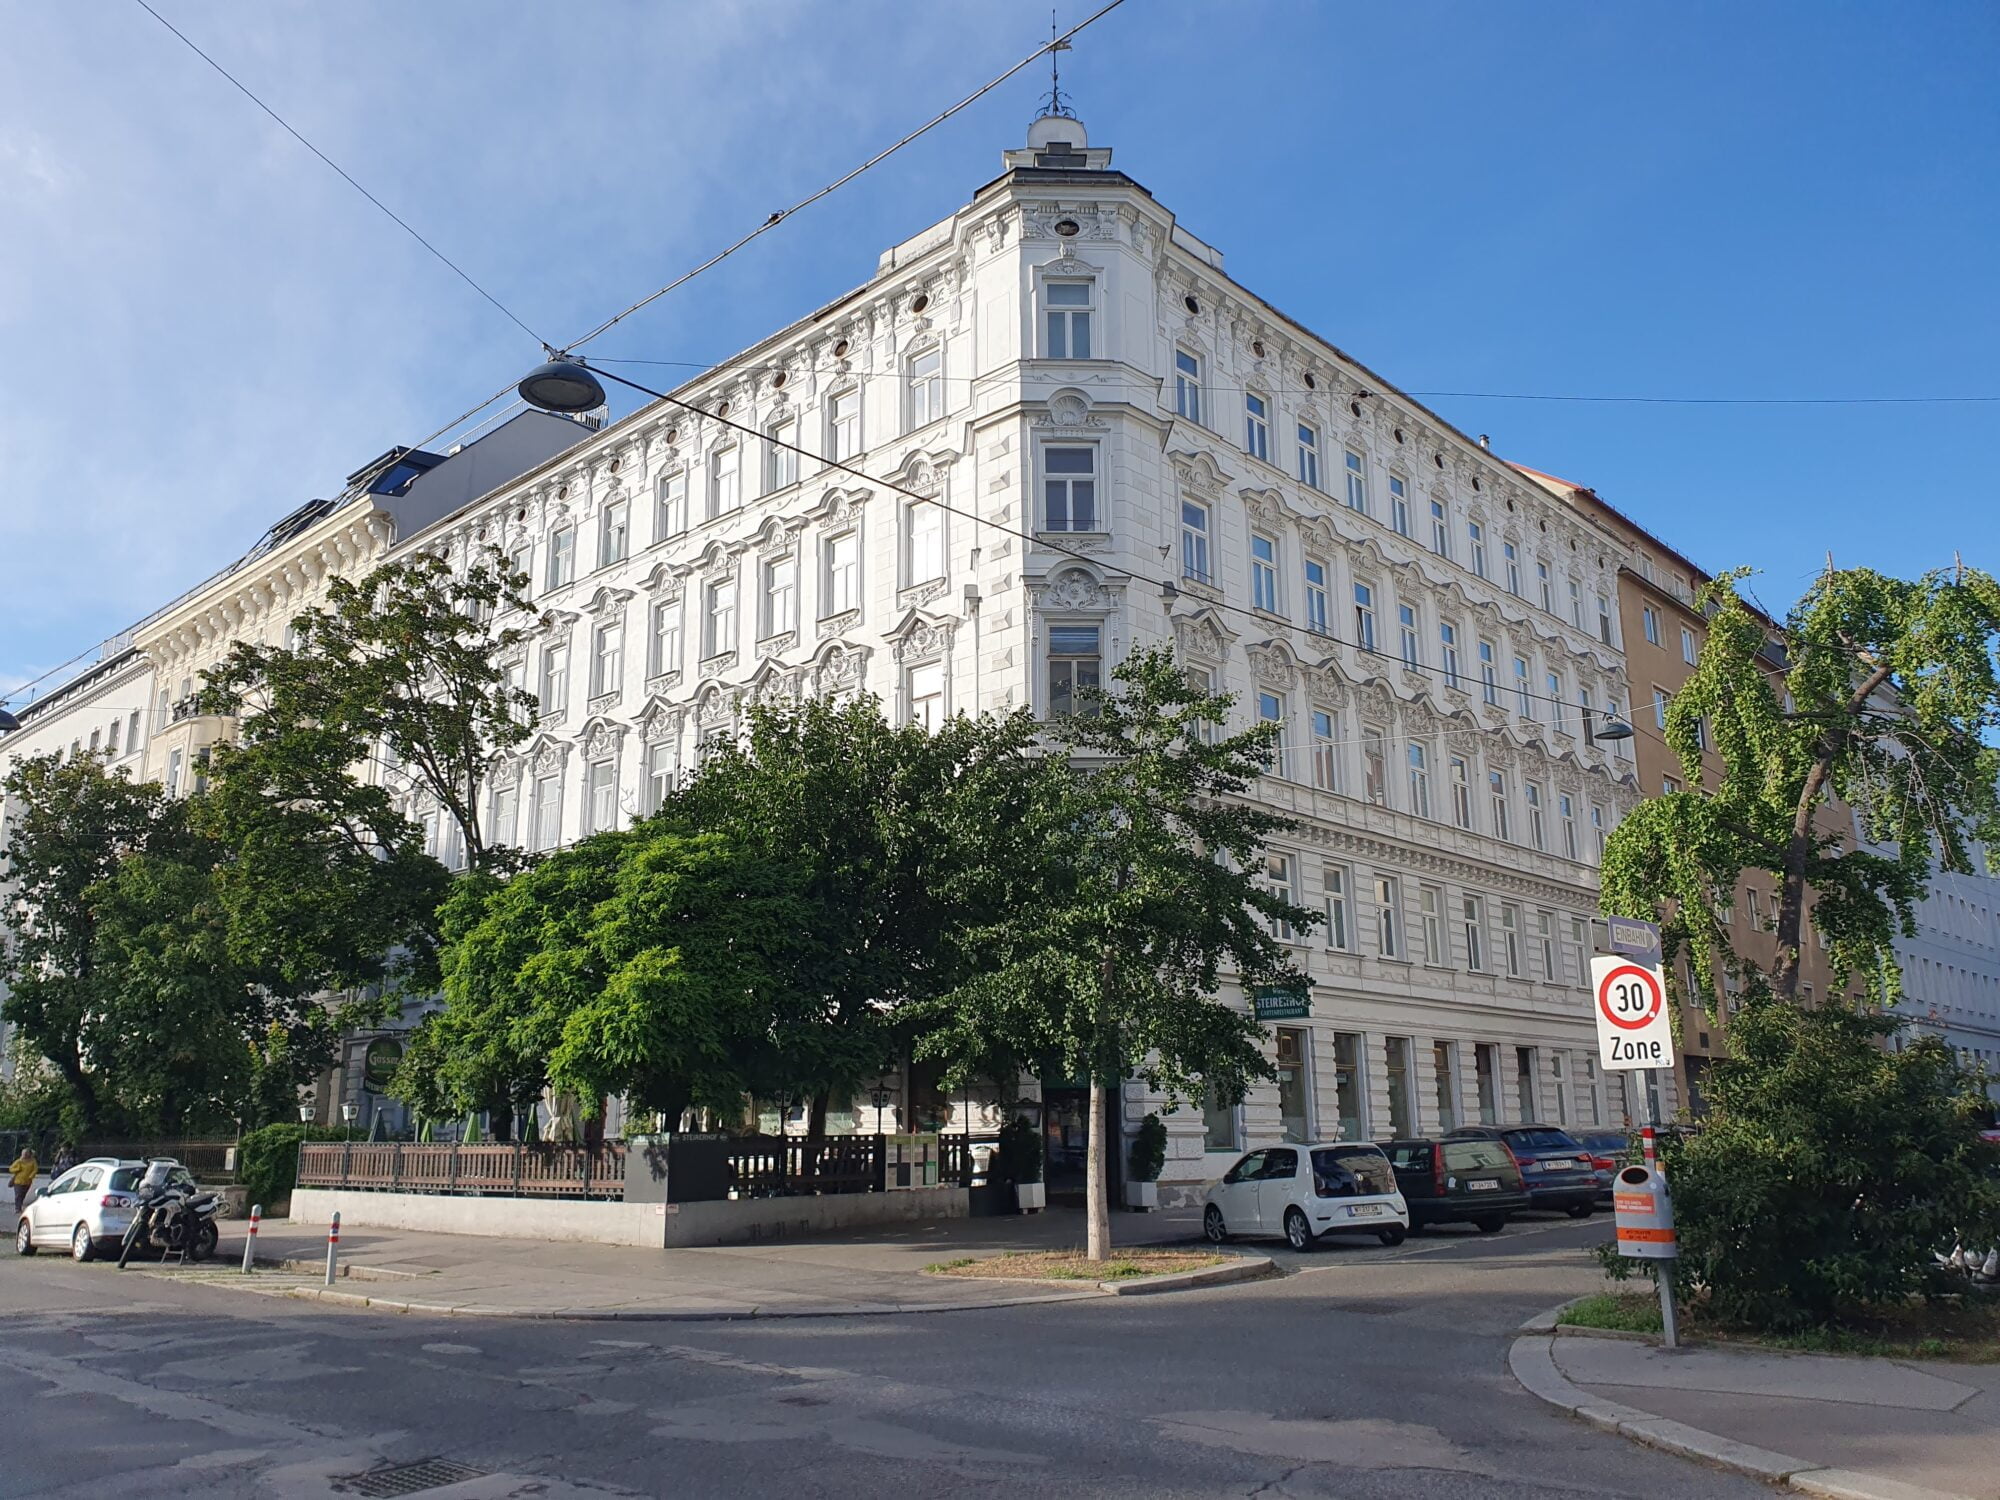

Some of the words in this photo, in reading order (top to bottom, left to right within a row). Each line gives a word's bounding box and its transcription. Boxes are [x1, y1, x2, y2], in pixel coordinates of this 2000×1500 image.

[1615, 927, 1646, 945] EINBAHN
[1615, 983, 1644, 1012] 30
[1610, 1036, 1662, 1061] Zone
